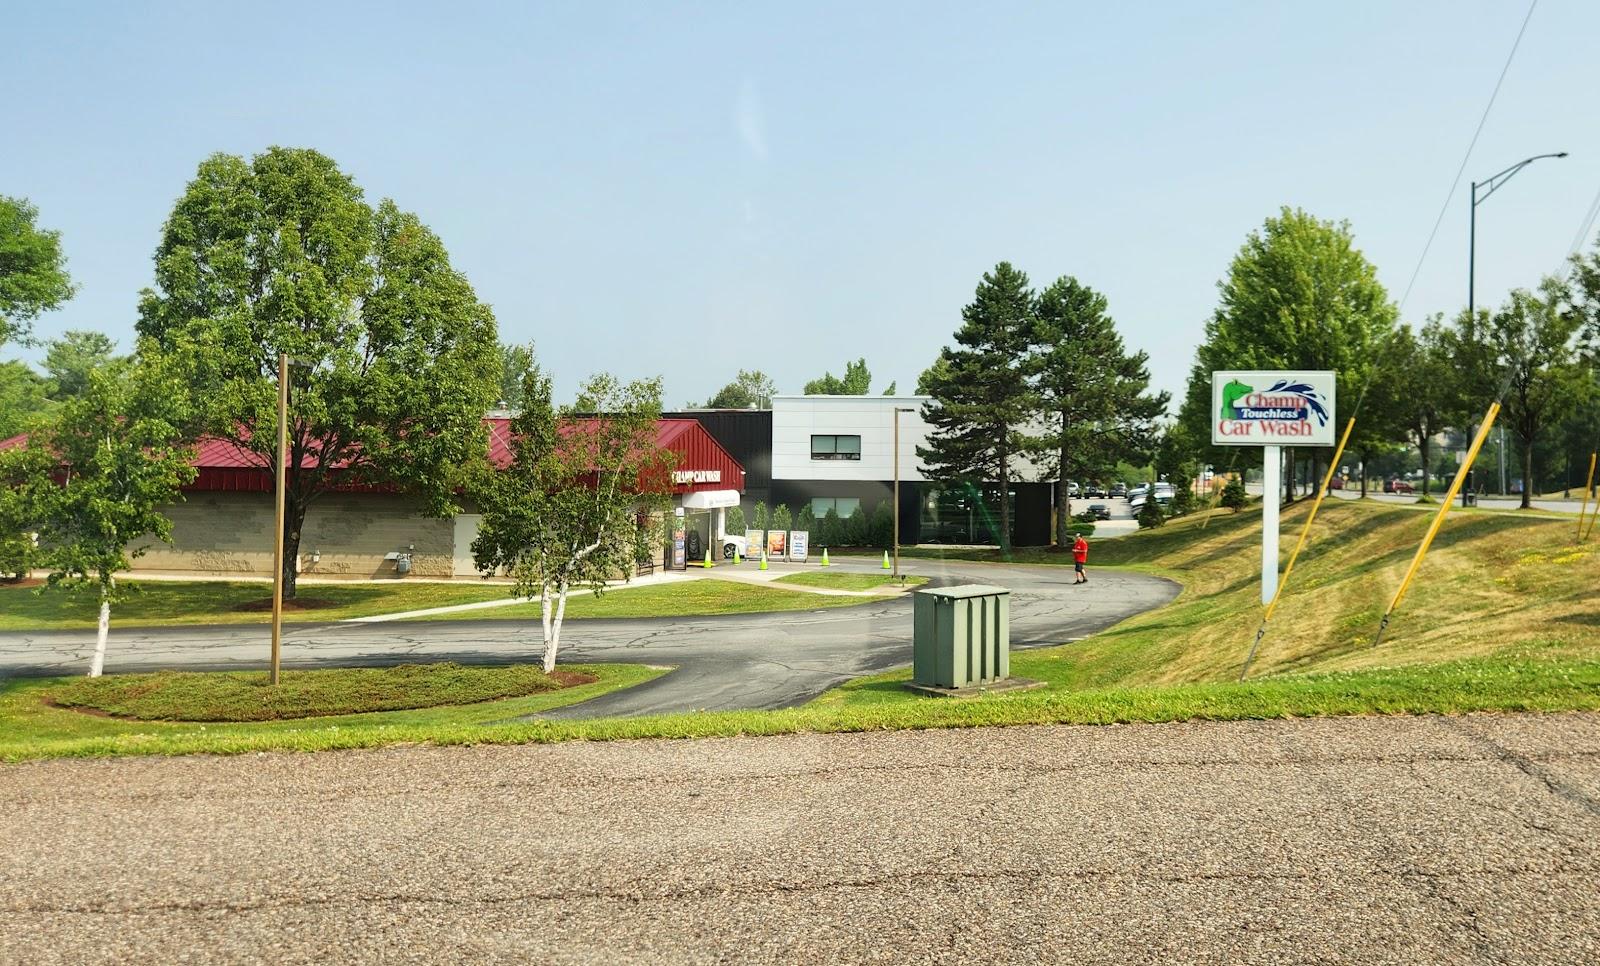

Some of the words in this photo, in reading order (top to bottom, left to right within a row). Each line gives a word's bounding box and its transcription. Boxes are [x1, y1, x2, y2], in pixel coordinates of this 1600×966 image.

[1245, 393, 1308, 411] Champ
[1240, 408, 1299, 419] Touchless
[1219, 420, 1253, 436] Car
[1260, 419, 1312, 436] Wash
[694, 471, 706, 482] CAR
